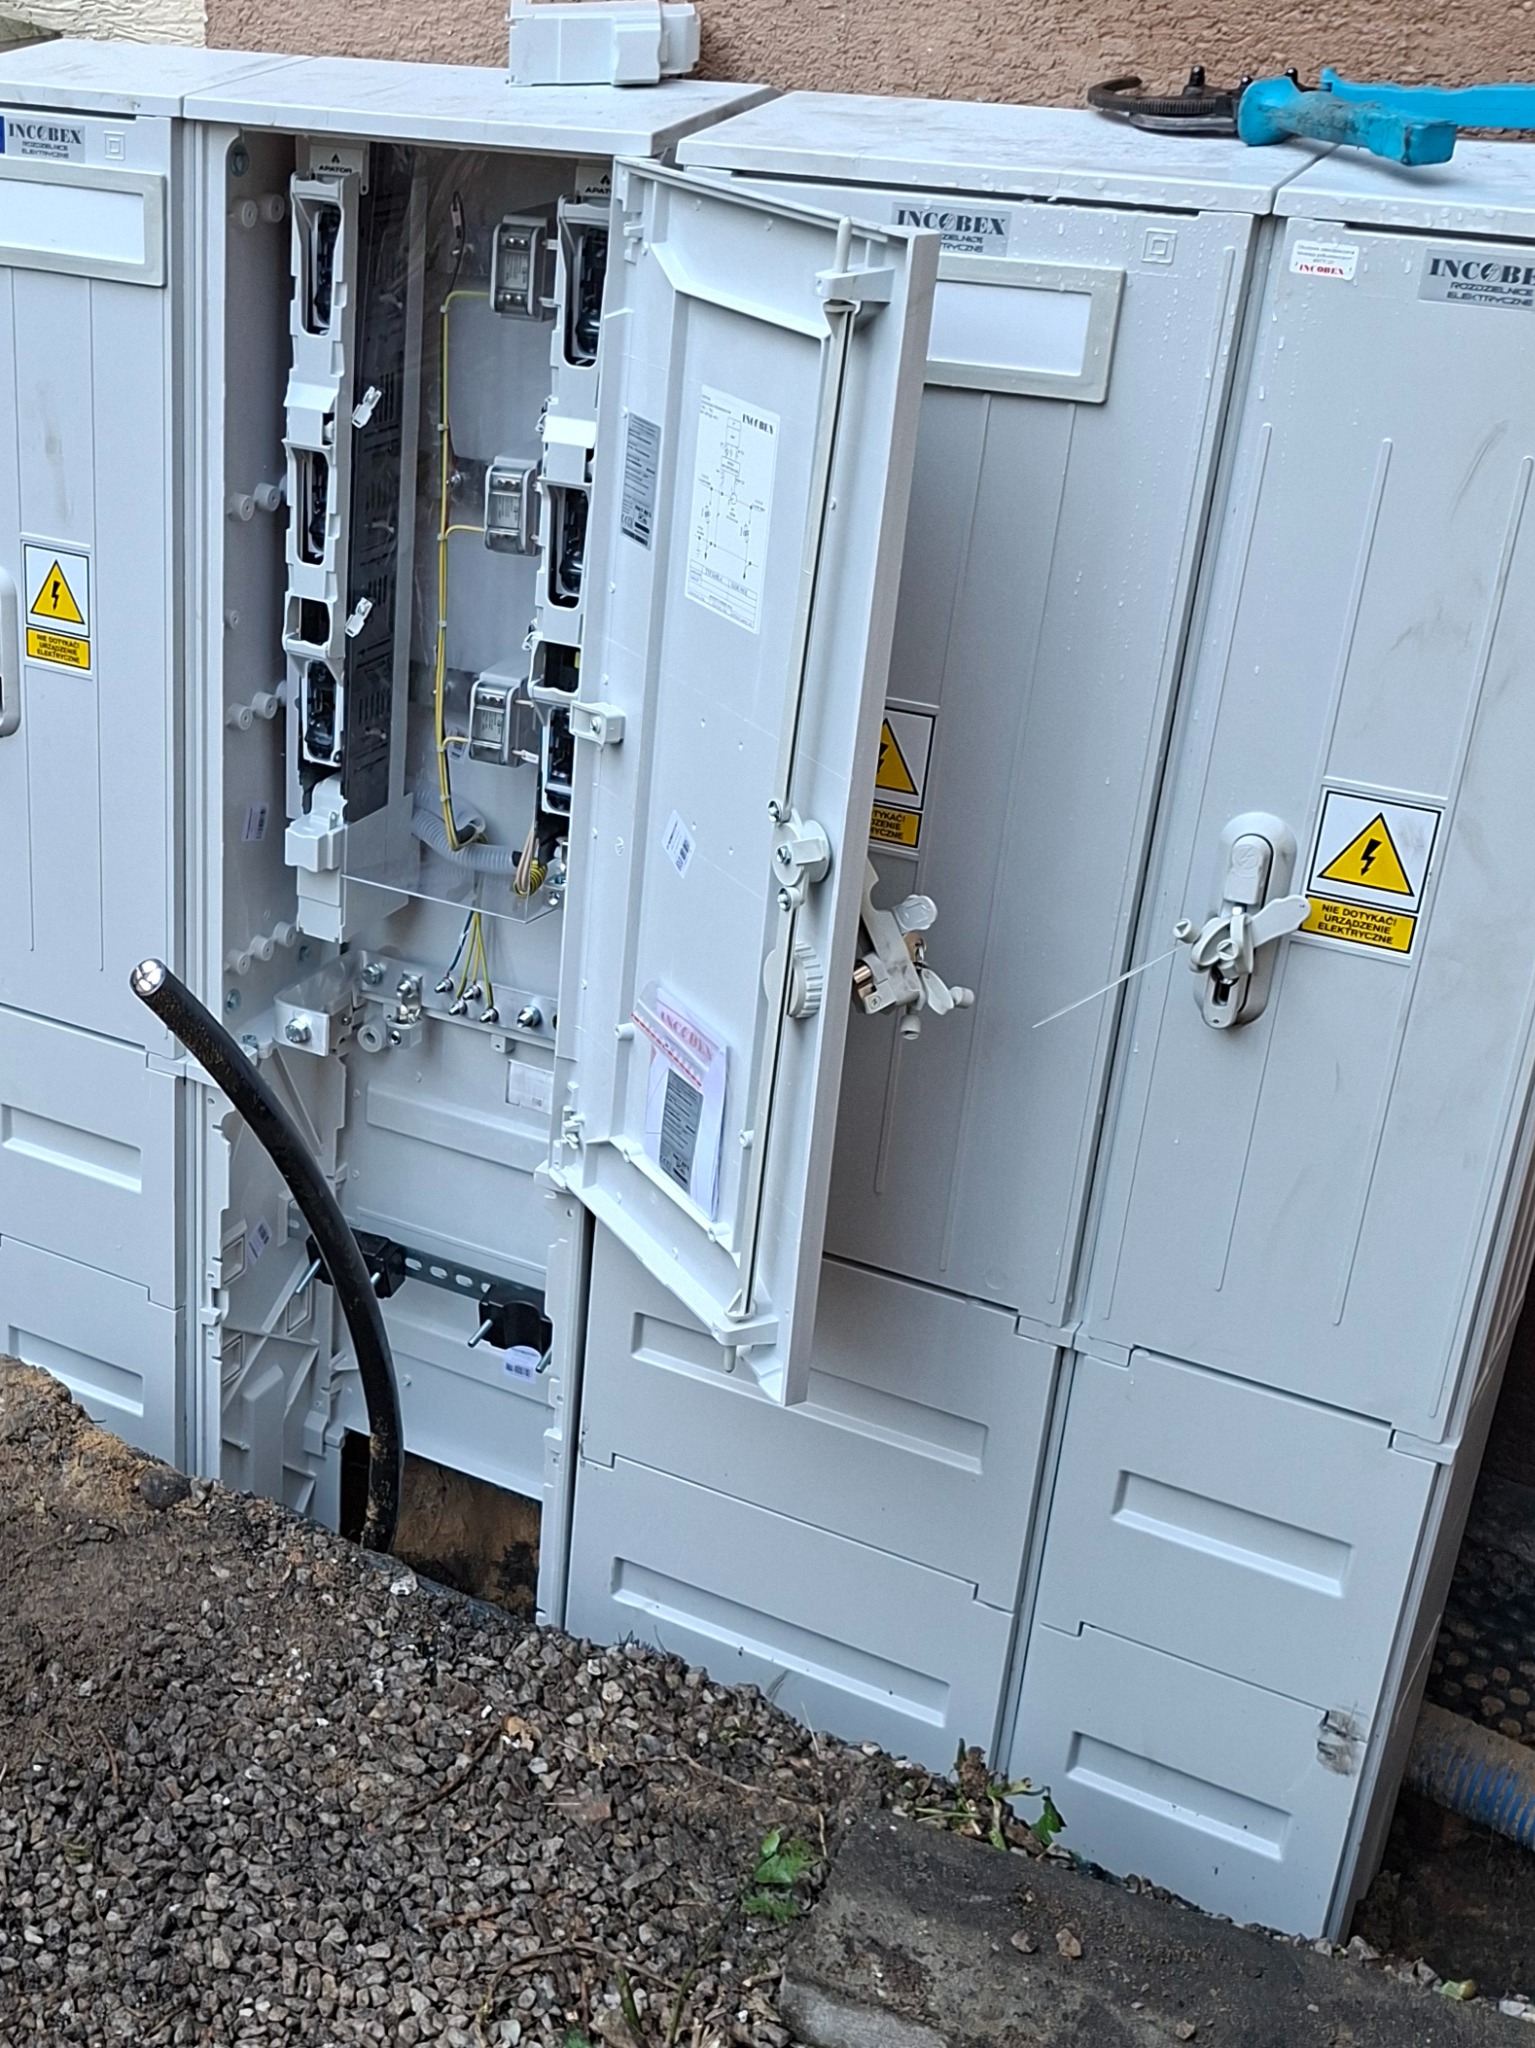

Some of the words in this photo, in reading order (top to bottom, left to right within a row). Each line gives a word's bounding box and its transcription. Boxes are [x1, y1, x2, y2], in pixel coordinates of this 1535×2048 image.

[9, 123, 82, 144] INCOBEX
[319, 164, 352, 173] APATOR
[897, 209, 1006, 236] INCOBEX
[1429, 258, 1535, 286] INCOBE
[1446, 291, 1533, 306] ELEKTRYCZNE
[1450, 282, 1533, 296] ROZDZIELNICE
[873, 810, 905, 823] TYKAĆ!
[1321, 904, 1340, 914] NIE
[1342, 908, 1397, 926] DOTYKAĆ!
[1324, 913, 1391, 935] URZĄDZENIE
[1317, 921, 1393, 944] ELEKTRYCZNE
